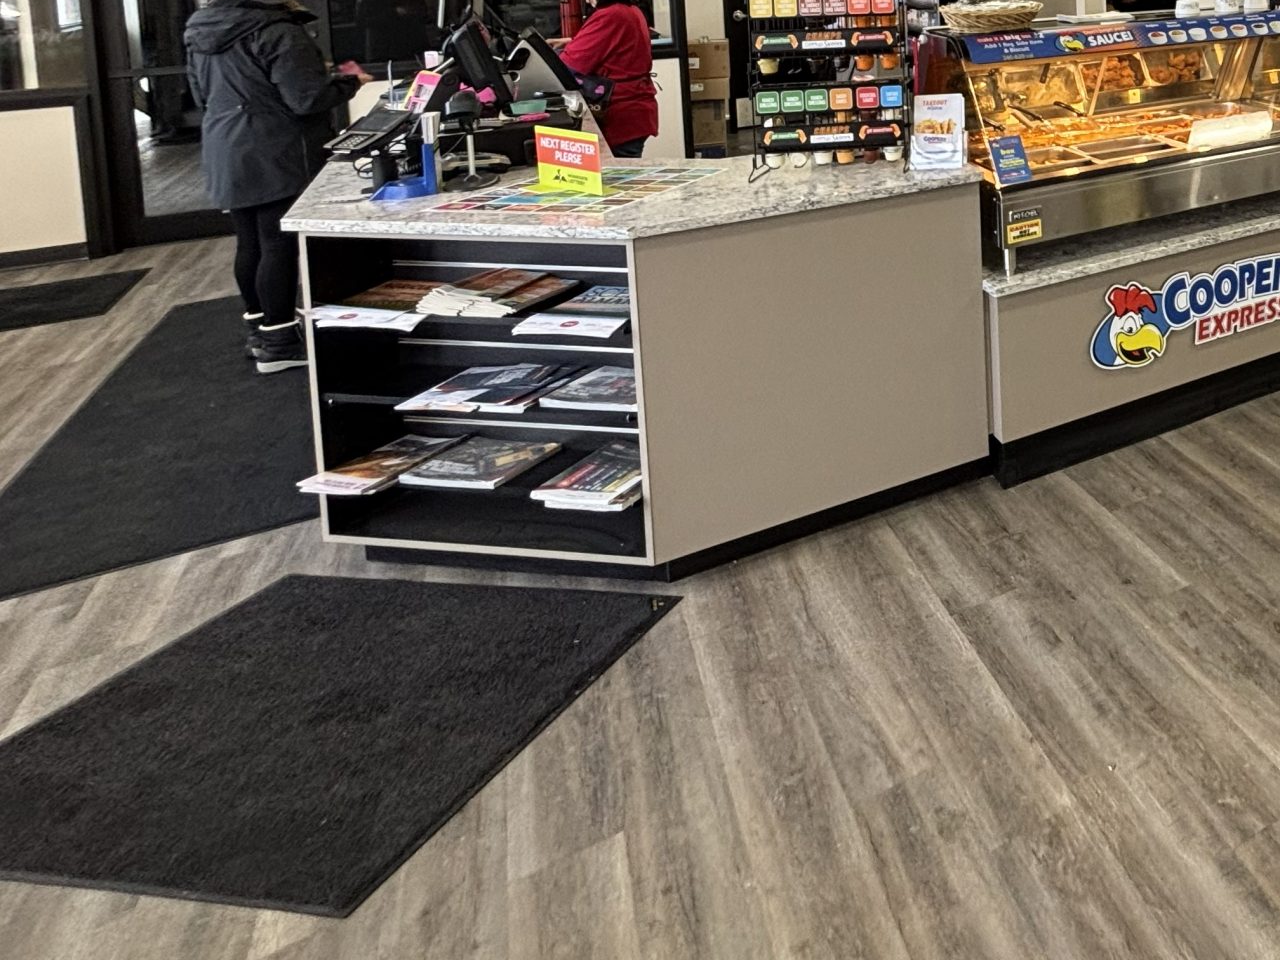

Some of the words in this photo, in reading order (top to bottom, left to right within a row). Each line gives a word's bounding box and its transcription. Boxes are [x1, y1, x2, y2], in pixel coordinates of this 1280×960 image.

[1087, 30, 1134, 46] SAUCE!
[540, 136, 559, 149] NEXT
[560, 140, 596, 155] REGISTER
[554, 150, 583, 165] PLEASE
